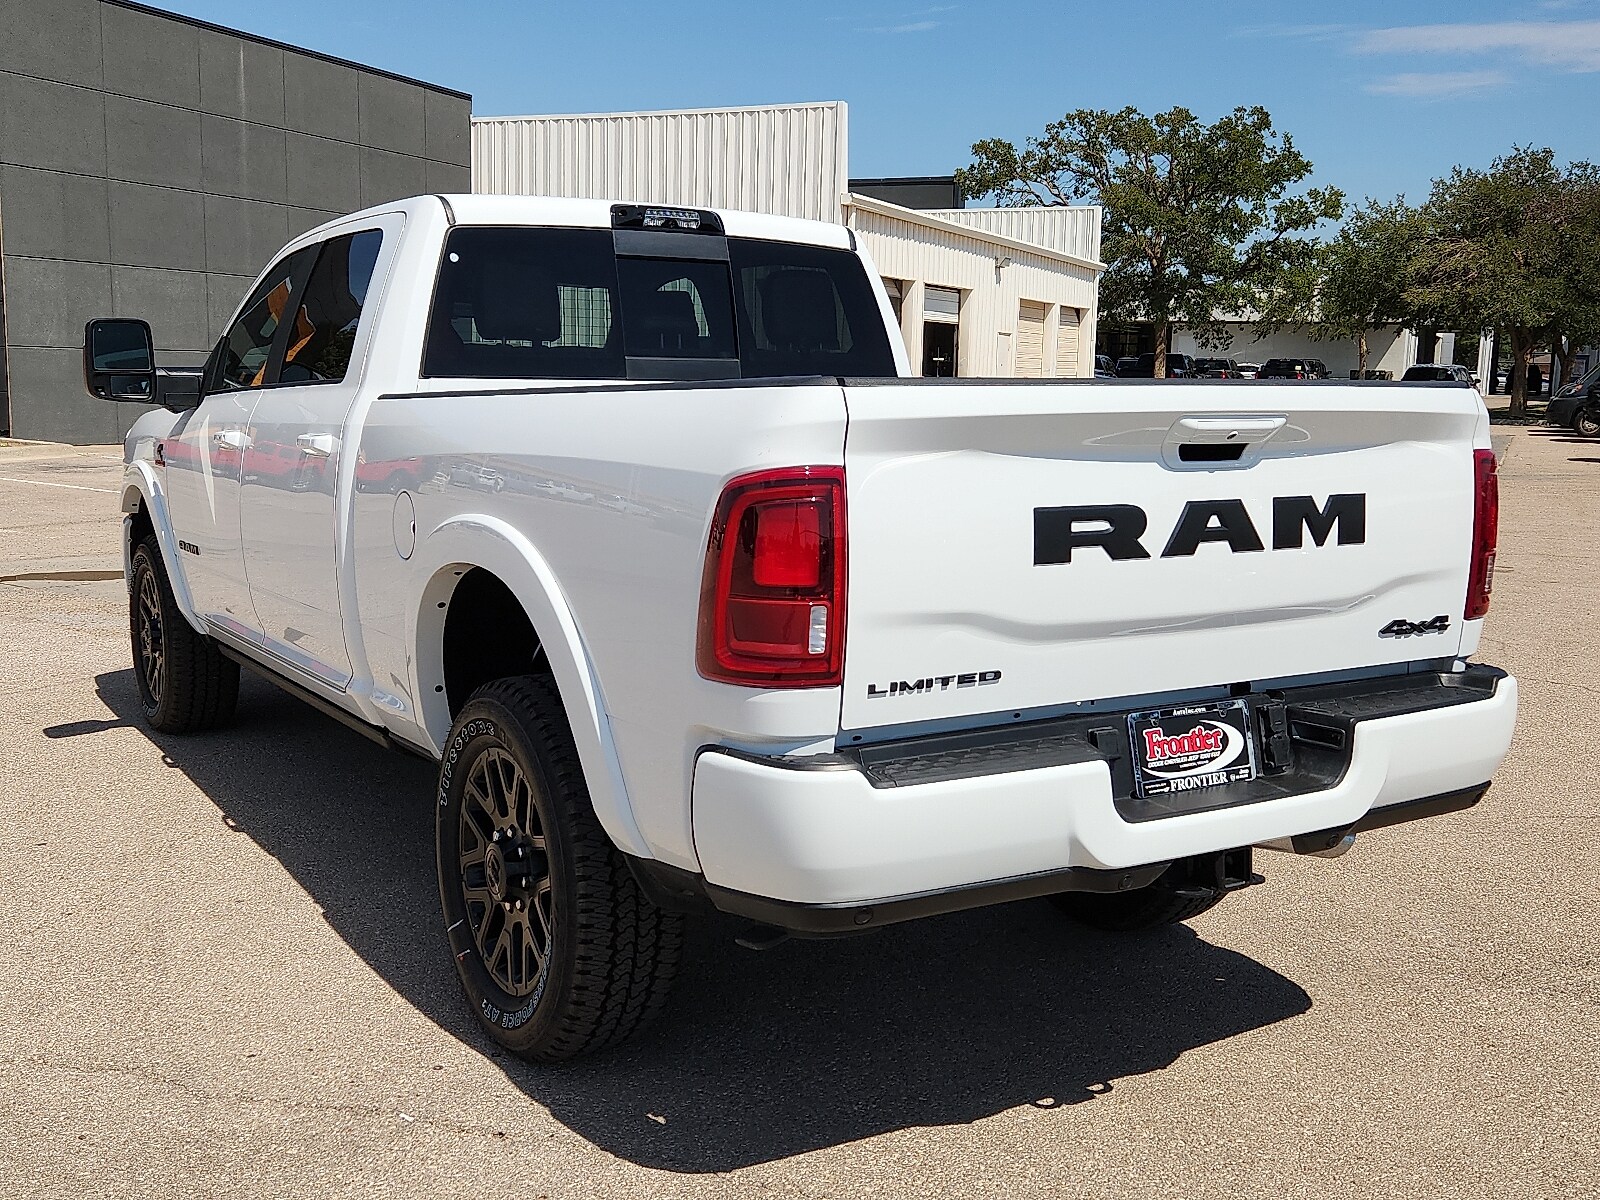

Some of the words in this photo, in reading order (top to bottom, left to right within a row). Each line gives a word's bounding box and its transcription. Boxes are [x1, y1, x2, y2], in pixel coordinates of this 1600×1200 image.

[1033, 492, 1366, 566] RAM
[1378, 615, 1451, 637] 4x4
[867, 670, 1002, 698] LIMITED
[1143, 725, 1224, 761] Frontier
[439, 720, 495, 807] Firestone
[1169, 771, 1228, 792] FRONTIER
